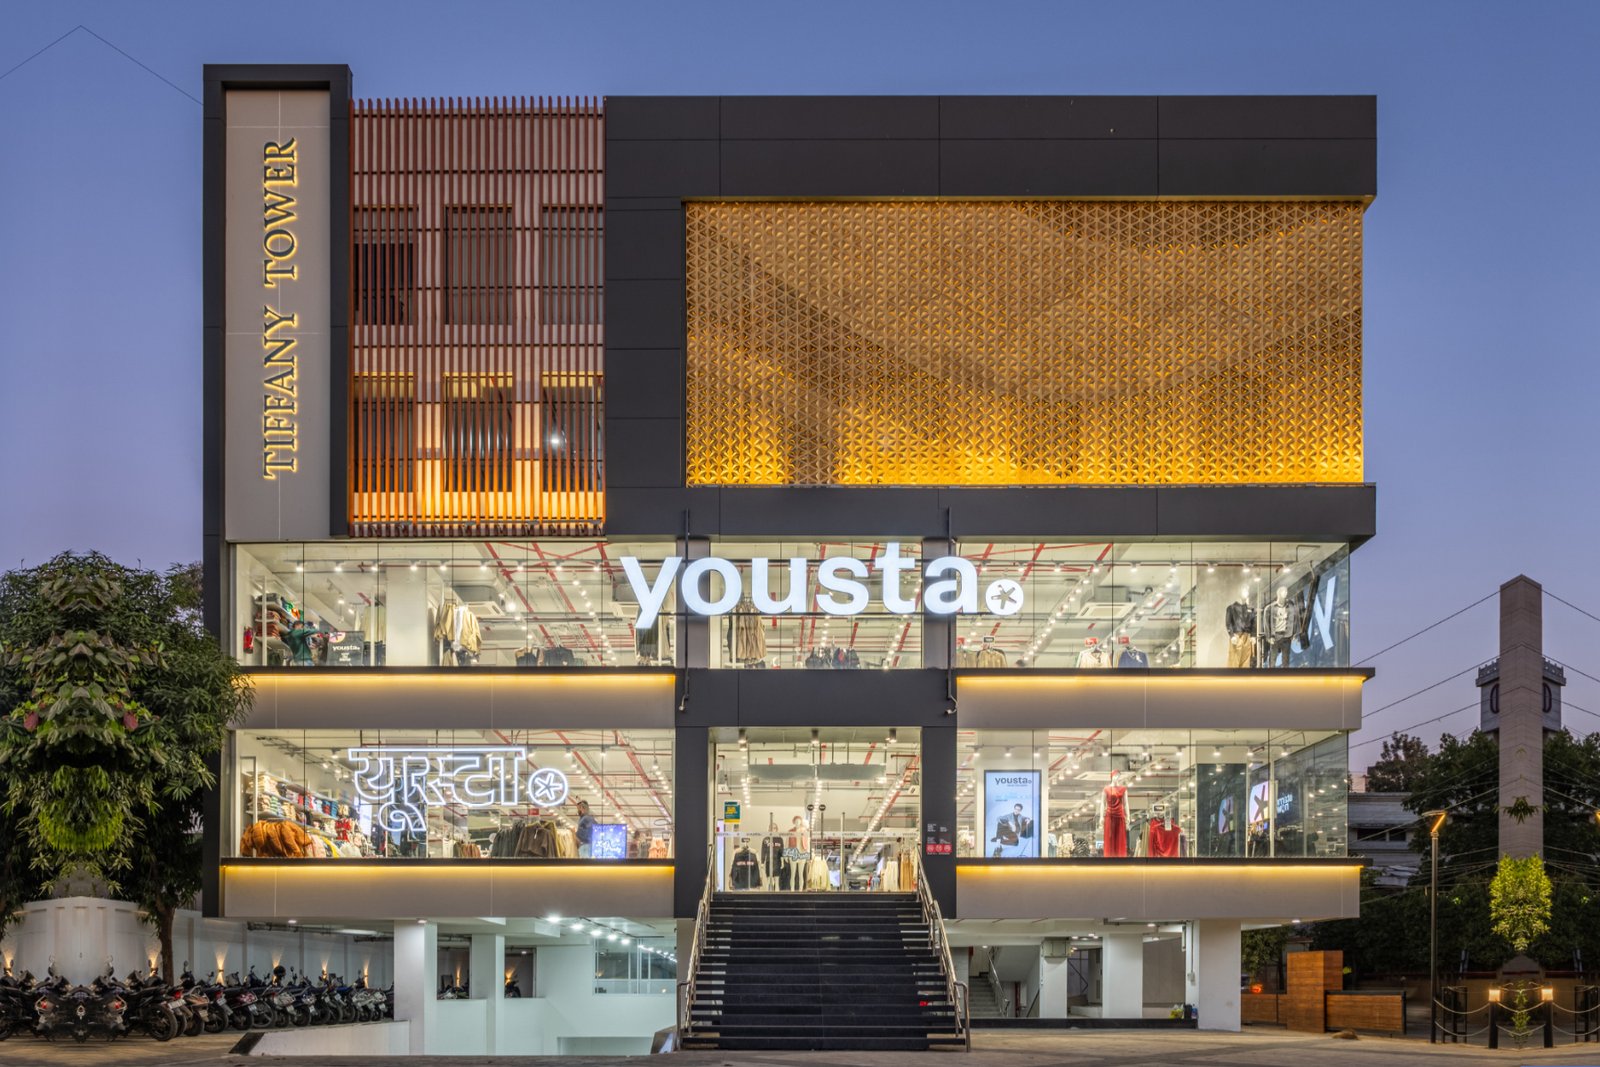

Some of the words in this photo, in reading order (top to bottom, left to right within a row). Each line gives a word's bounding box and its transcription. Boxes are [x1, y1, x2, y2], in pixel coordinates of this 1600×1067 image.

[263, 137, 297, 288] TOWER
[263, 304, 297, 480] TIFFANY
[619, 542, 979, 629] yousta
[348, 748, 526, 832] यूस्टा
[995, 776, 1028, 785] yousta
